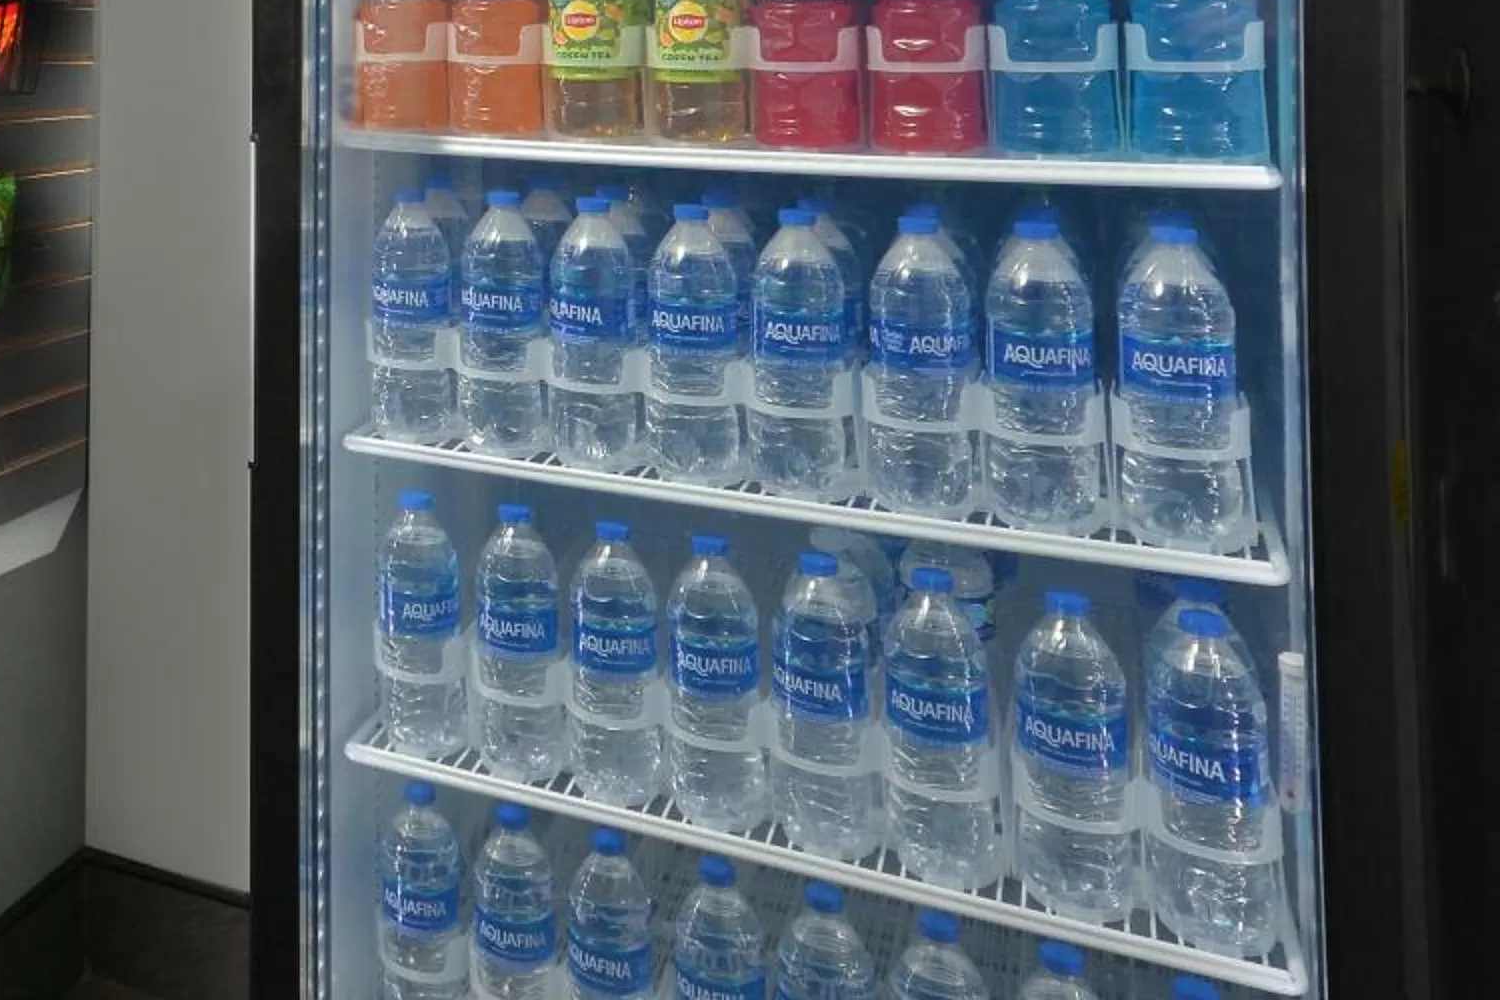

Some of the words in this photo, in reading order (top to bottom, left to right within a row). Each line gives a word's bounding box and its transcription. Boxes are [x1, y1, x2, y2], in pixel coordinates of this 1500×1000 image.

[551, 298, 603, 325] QUAFINA
[652, 310, 724, 334] AQUAFINA
[765, 321, 841, 345] AQUAFINA
[909, 335, 967, 357] AQUAF
[1004, 344, 1092, 369] AQUAFINA
[1132, 351, 1227, 377] AQUAFINA
[579, 633, 649, 657] AQUAFINA
[677, 651, 751, 677] AQUAFINA
[892, 690, 975, 724] AQUAFINA
[1025, 716, 1115, 752] AQUAFINA
[1150, 733, 1226, 783] QUAFINA
